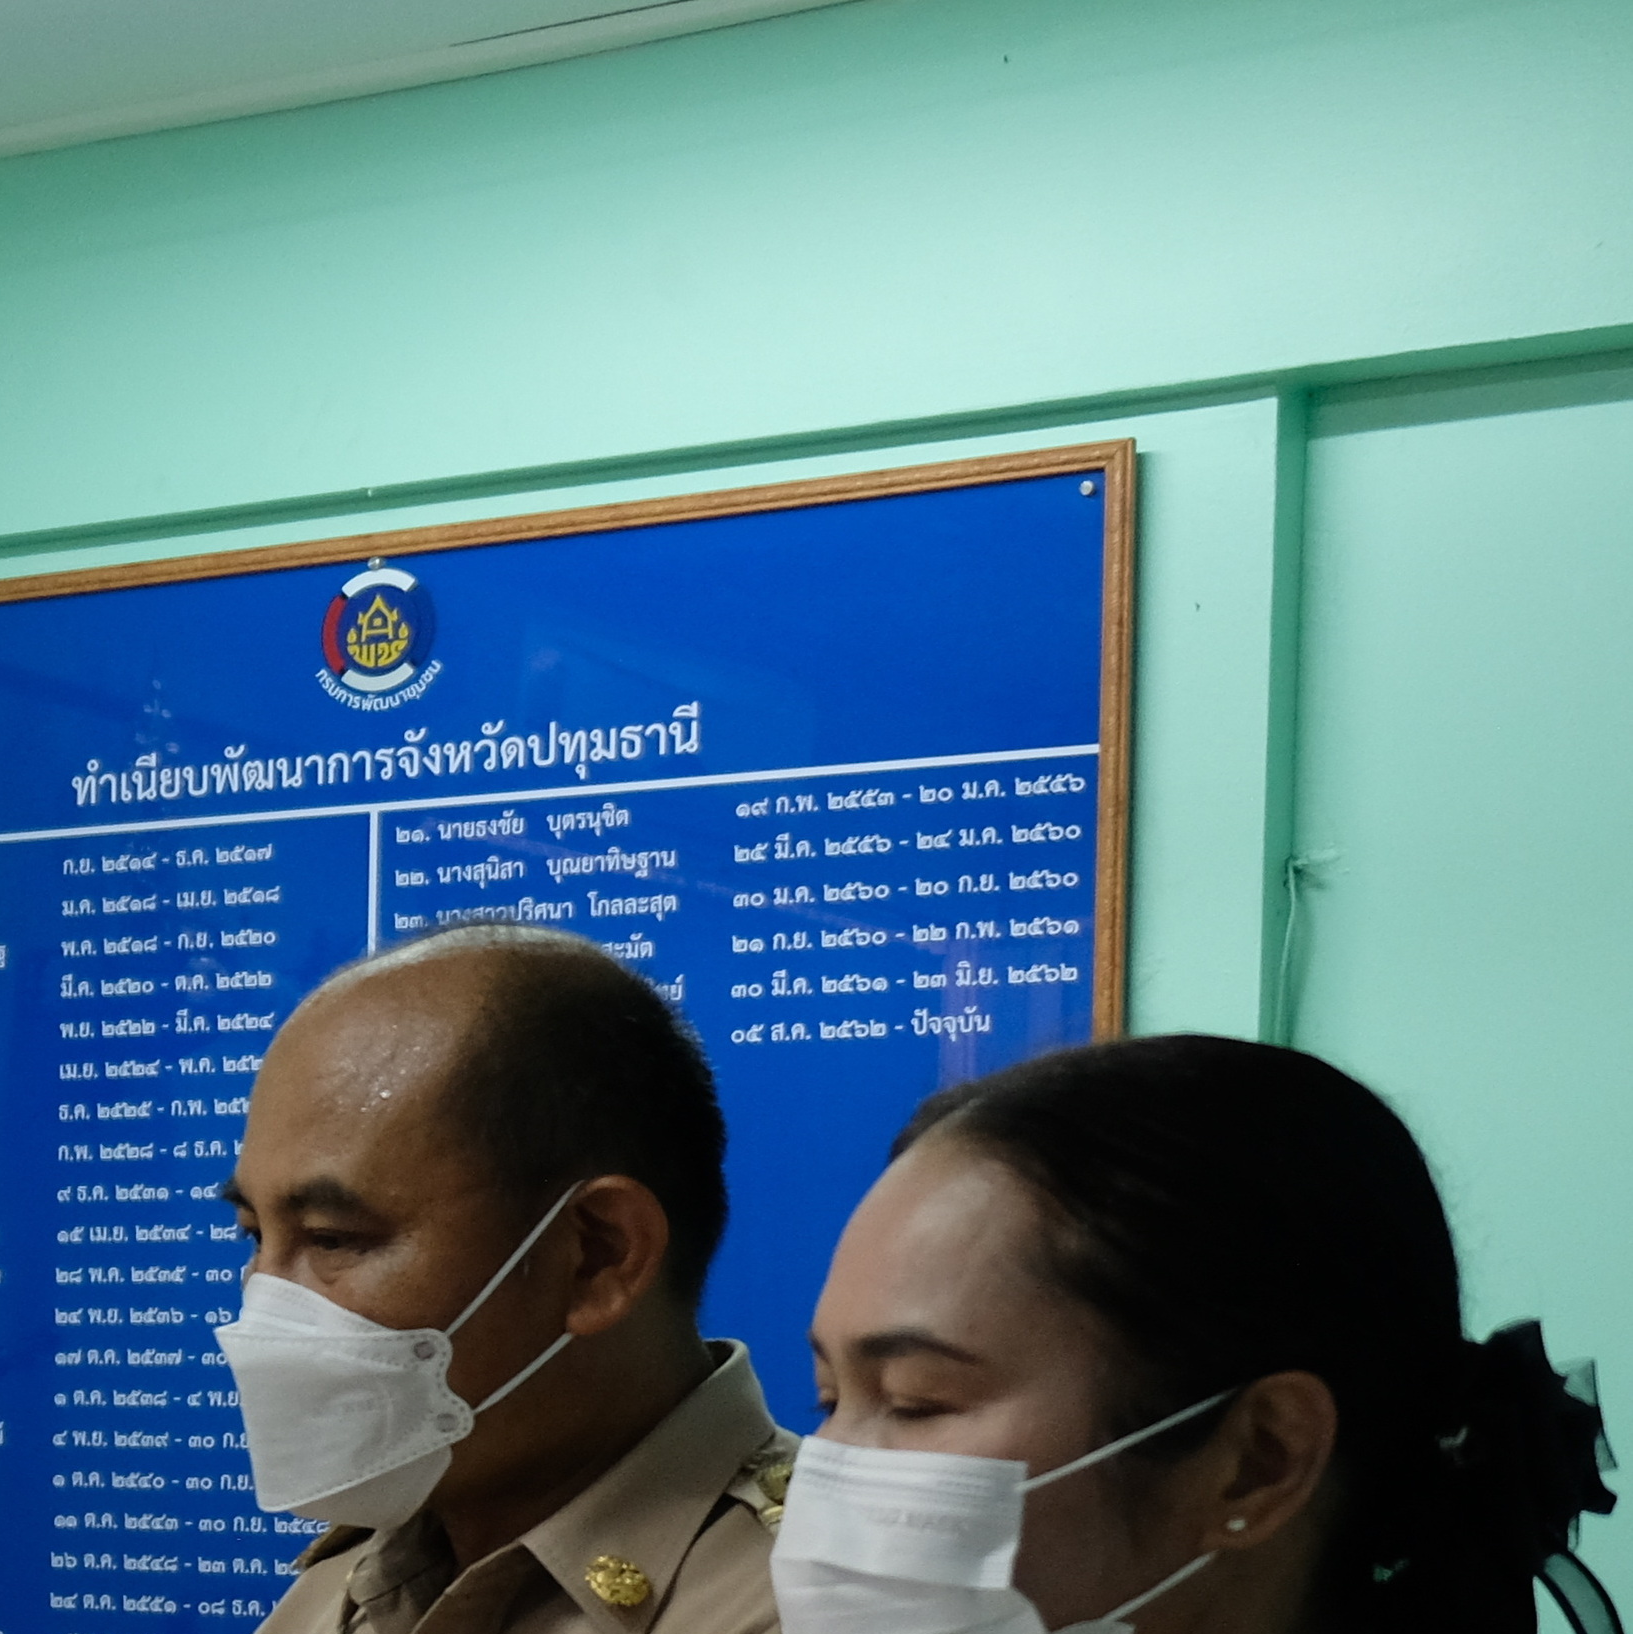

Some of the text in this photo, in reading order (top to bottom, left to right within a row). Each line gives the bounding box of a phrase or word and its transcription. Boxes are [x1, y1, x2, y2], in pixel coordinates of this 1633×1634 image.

[70, 699, 702, 807] ทำเนียบพัฒนาการจังหวัดปทุมธานี
[736, 774, 1085, 817] ๑๙ ก.พ. ๒๕๕๓ ๒๐ ม.ค. ๒๕๕๖
[396, 803, 629, 843] ๒๑. นายธงชัย บุตรนุชิต
[734, 822, 1081, 862] ๒๕ มี.ค. ๒๕๕๖ ๒๔ ม.ค. ๒๕๖๐
[64, 844, 272, 874] ก.ย. ๒๕๑๔ ธ.ค. ๒๕๑๗
[395, 847, 675, 889] ๒๒. นางสุนิสา บุณยาทิษฐาน
[733, 870, 1079, 907] ๓๐ ม.ค. ๒๕๖๐ ๒๐ ก.ย. ๒๕๖๐
[62, 886, 280, 916] ม.ค. ๒๕๑๘ เม.ย. ๒๕๑๘
[394, 913, 428, 929] ๒๓.
[61, 929, 276, 956] พ.ค. ๒๕๑๘ ก.ย. ๒๕๒๐
[732, 917, 1080, 952] ๒๑ ก.ย. ๒๕๖๐ ๒๒ ก.พ. ๒๕๖๑
[61, 971, 273, 998] มี.ค. ๒๕๒๐ ต.ค. ๒๕๒๒
[731, 961, 1078, 997] ๓๐ มี.ค. ๒๕๖๑ ๒๓ มิ.ย. ๒๕๖๒
[60, 1009, 274, 1038] พ.ย. ๒๕๒๒ มี.ค. ๒๕๒๔
[731, 1006, 991, 1043] ๐๕ ส.ค. ๒๕๖๒ ปัจจุบัน
[60, 1058, 215, 1079] เม.ย. ๒๕๒๔ พ.ค.
[59, 1100, 207, 1120] ธ.ค. ๒๕๒๕ ก.พ.
[100, 1143, 153, 1159] ๒๕๒๘
[194, 1141, 227, 1157] ธ.ค.
[77, 1184, 169, 1201] ธ.ค. ๒๕๓๑
[90, 1224, 191, 1241] เม.ย. ๒๕๓๔
[89, 1266, 186, 1283] พ.ค. ๒๕๓๕
[88, 1308, 184, 1323] พ.ย. ๒๕๓๖
[127, 1349, 182, 1365] ๒๕๓๗
[114, 1390, 167, 1406] ๒๕๓๘
[73, 1431, 168, 1447] พ.ย. ๒๕๓๙
[112, 1472, 165, 1488] ๒๕๔๐
[221, 1475, 254, 1490] ก.ย.
[125, 1513, 178, 1530] ๒๕๔๓
[234, 1516, 267, 1532] ก.ย.
[124, 1554, 178, 1572] ๒๕๔๘
[233, 1558, 267, 1574] ต.ค.
[123, 1595, 176, 1613] ๒๕๕๑
[232, 1600, 265, 1616] ธ.ค.
